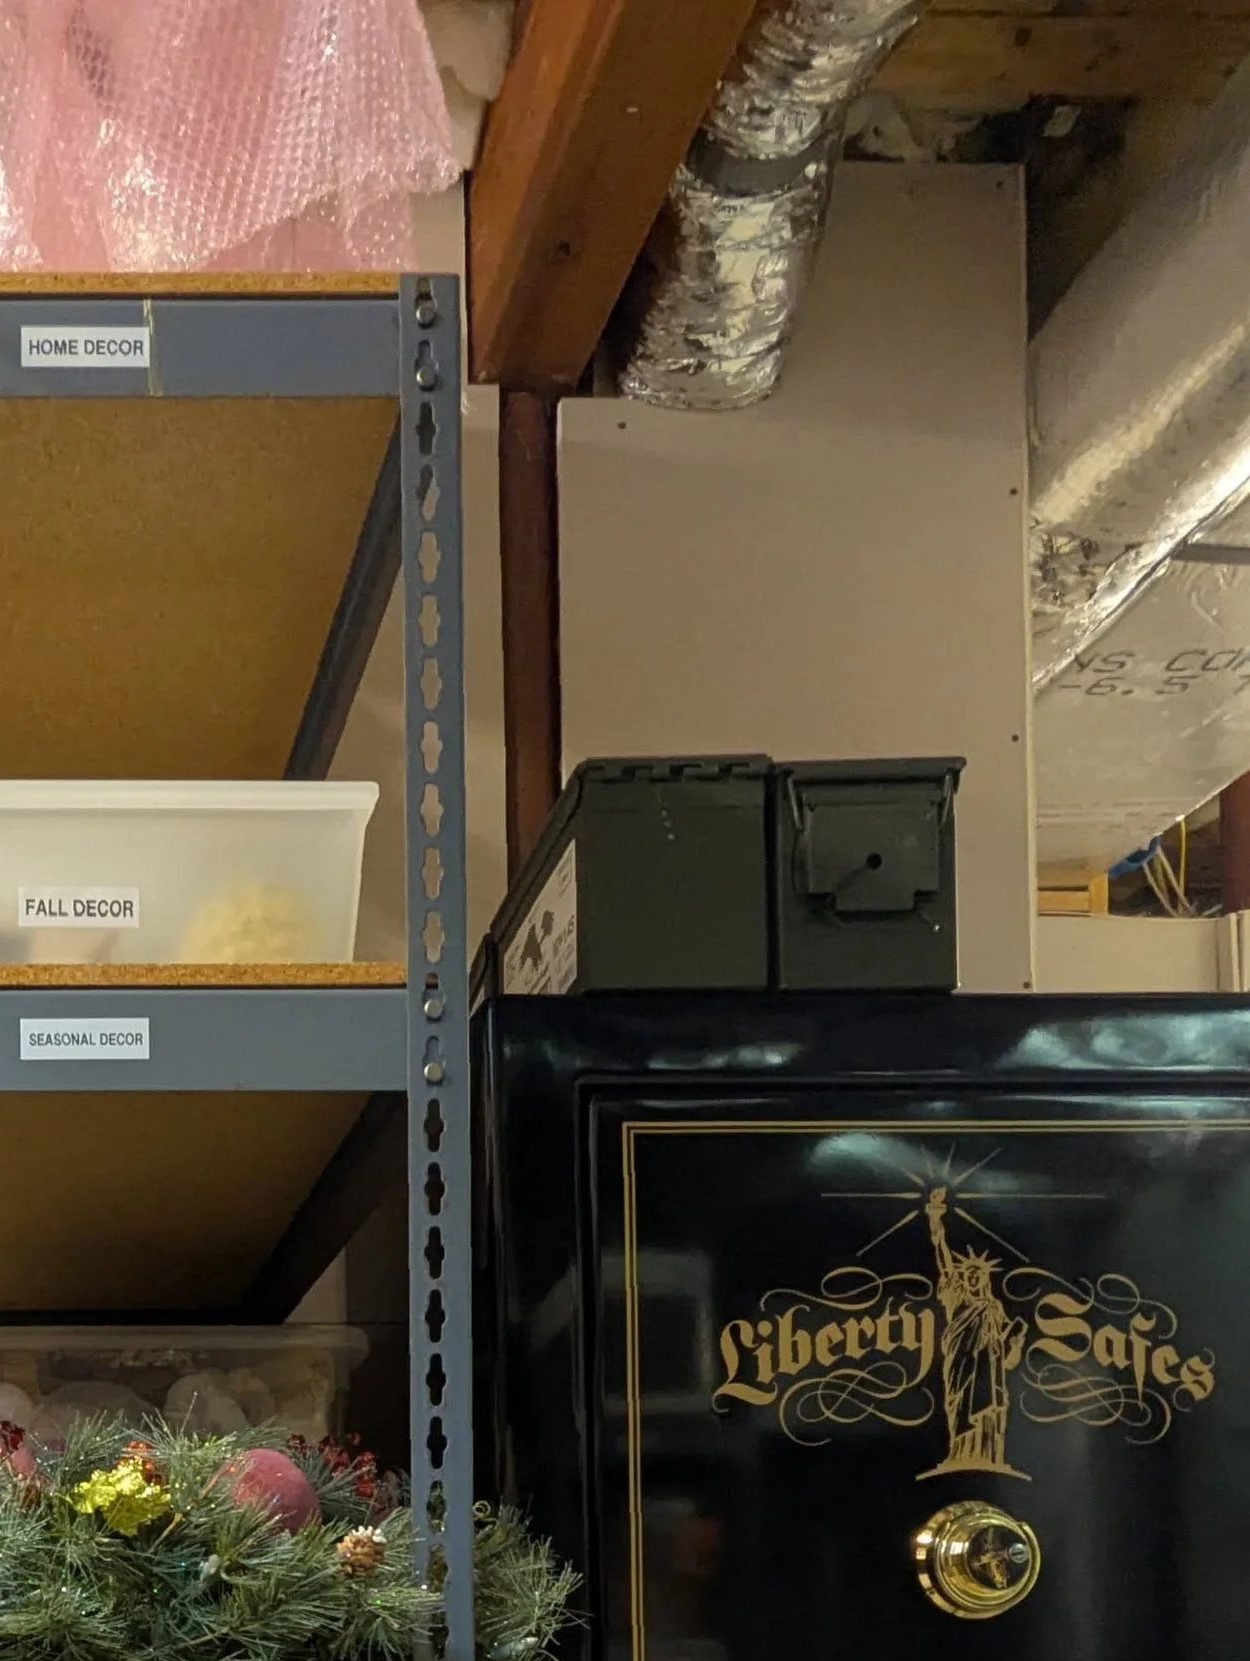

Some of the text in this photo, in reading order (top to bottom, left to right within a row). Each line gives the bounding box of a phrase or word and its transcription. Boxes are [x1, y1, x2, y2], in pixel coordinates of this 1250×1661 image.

[29, 339, 144, 356] HOME DECOR
[25, 899, 134, 918] FALL DECOR
[29, 1032, 143, 1047] SEASONAL DECOR
[716, 1292, 1216, 1409] Liberty Safes
